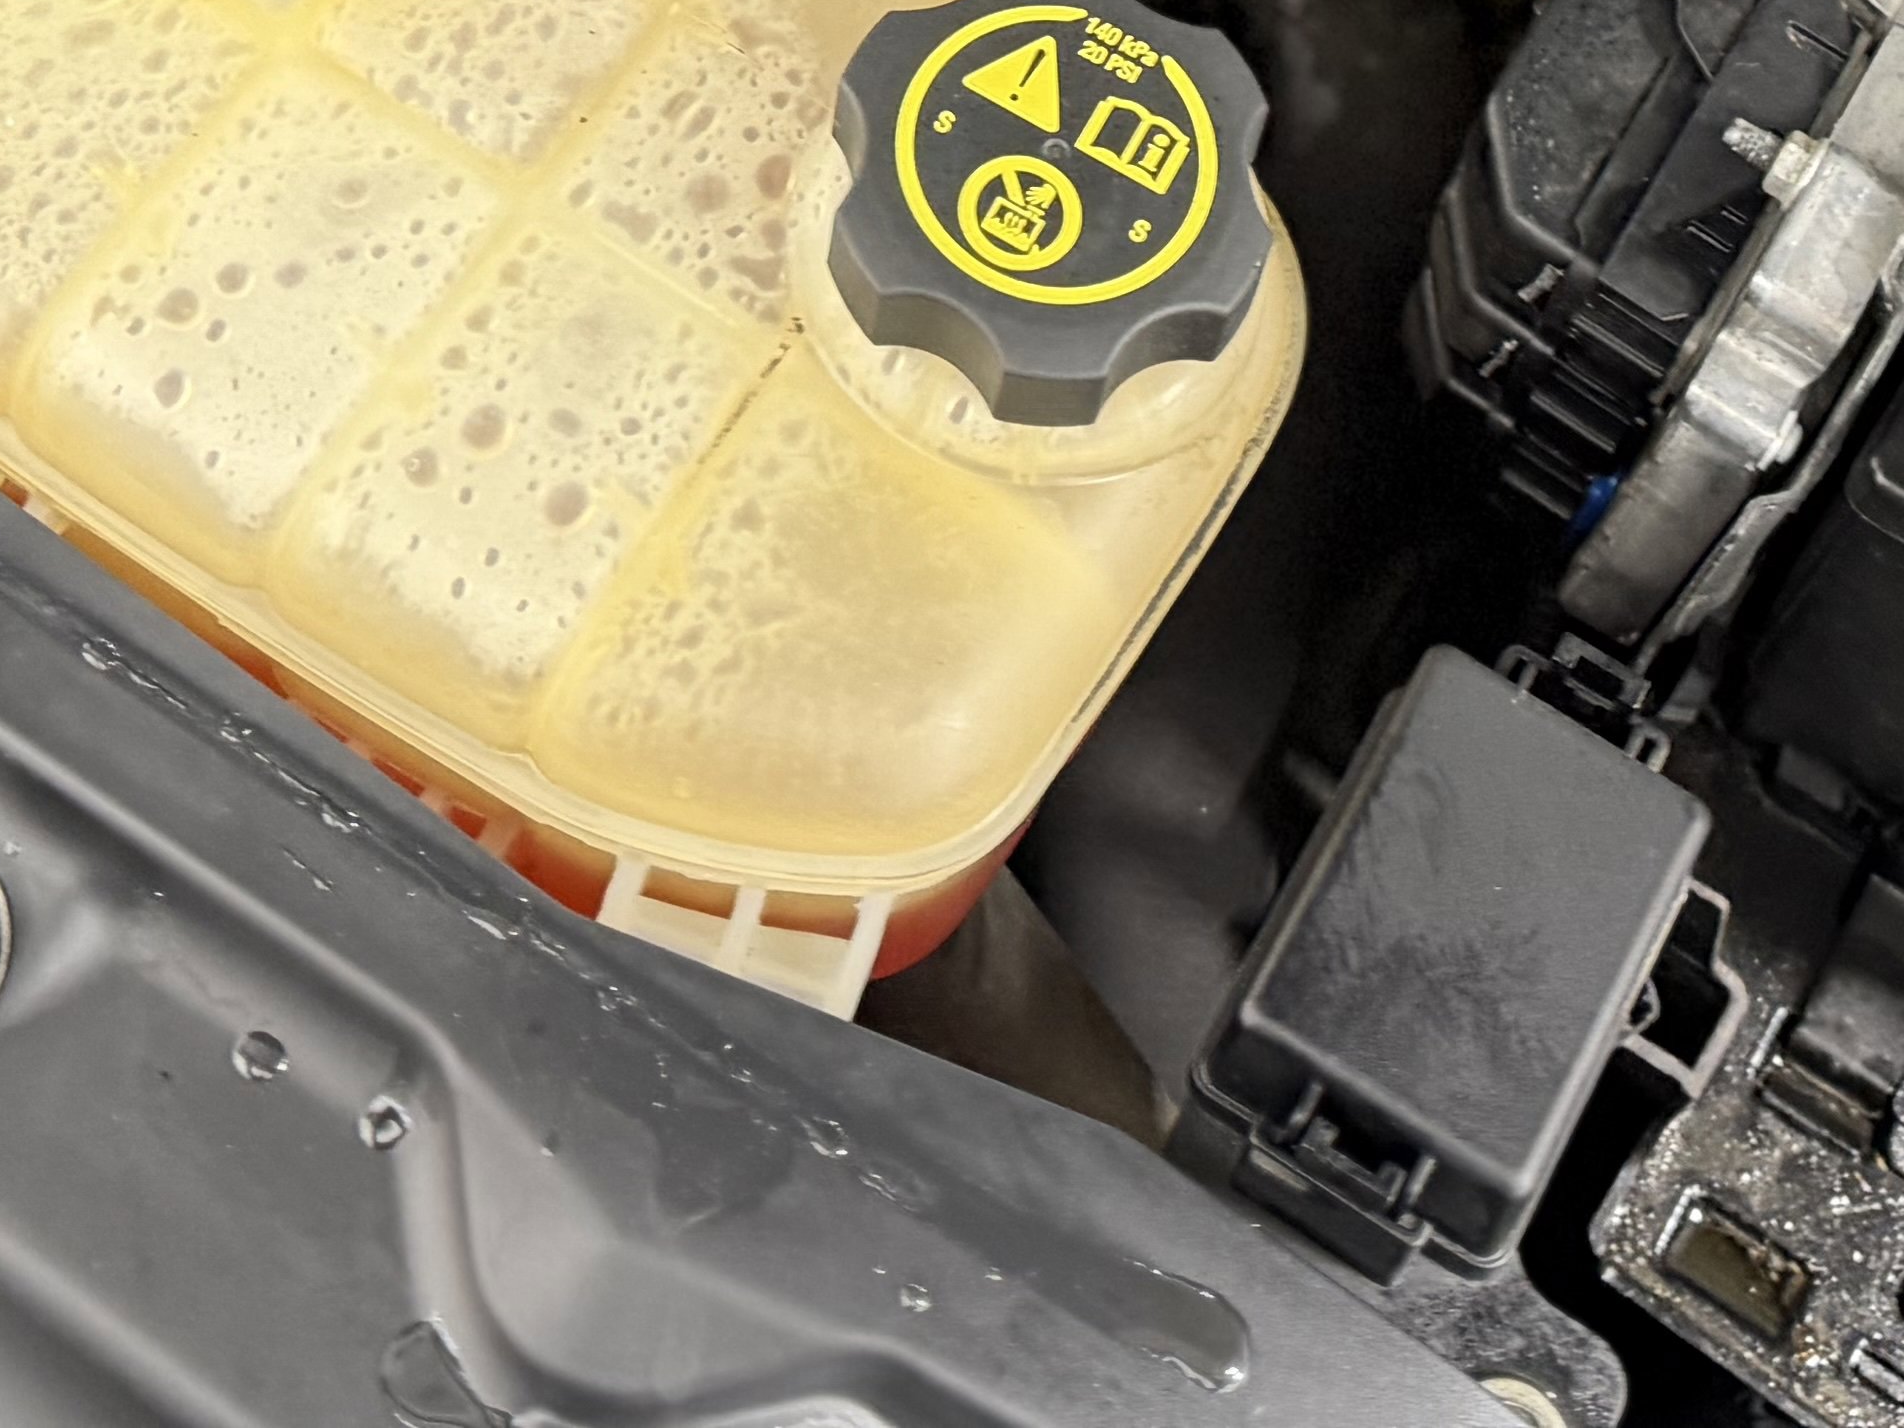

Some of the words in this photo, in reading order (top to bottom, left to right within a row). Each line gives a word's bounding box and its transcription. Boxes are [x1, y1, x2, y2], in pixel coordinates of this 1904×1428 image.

[1078, 40, 1108, 65] 20
[1106, 55, 1143, 84] PSI
[1086, 17, 1124, 48] 140
[1118, 34, 1160, 68] kPa
